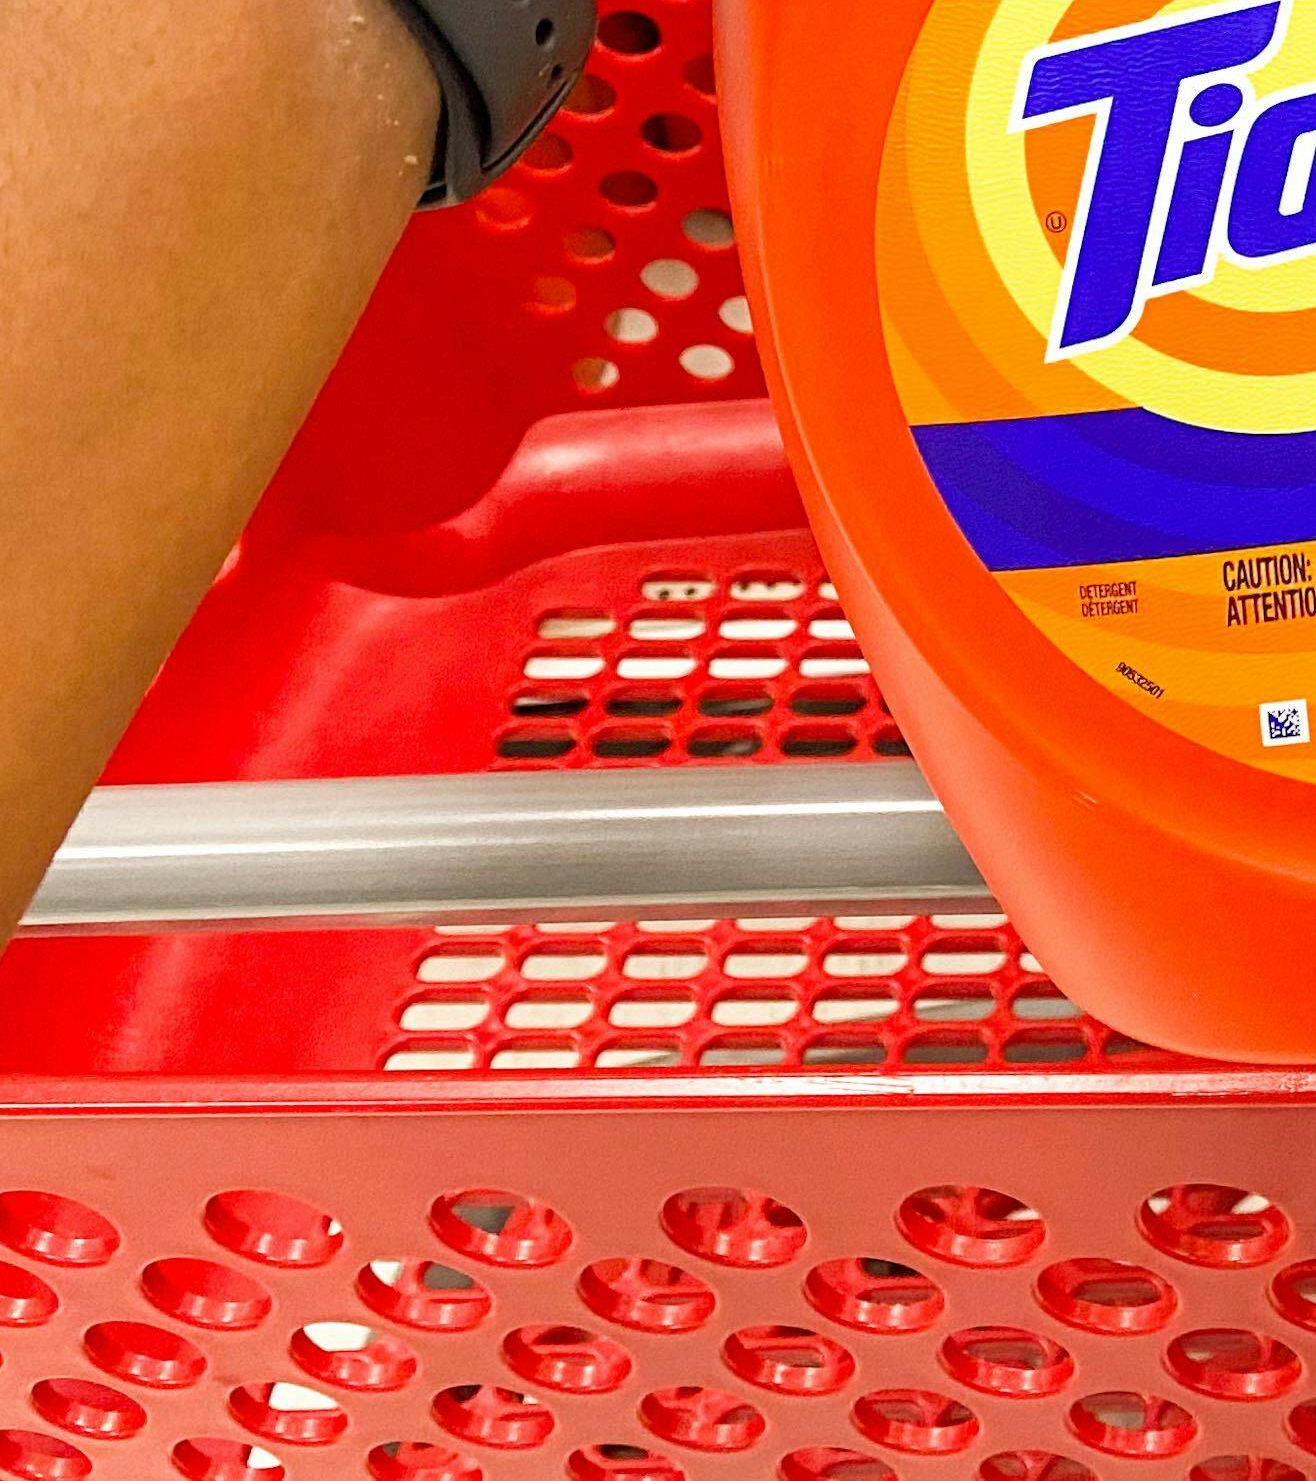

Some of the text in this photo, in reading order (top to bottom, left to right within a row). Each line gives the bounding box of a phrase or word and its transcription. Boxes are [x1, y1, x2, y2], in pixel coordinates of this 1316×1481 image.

[1223, 552, 1312, 591] CAUTION:
[1080, 581, 1137, 599] DETERGENT
[1081, 599, 1138, 617] DÉTERGENT
